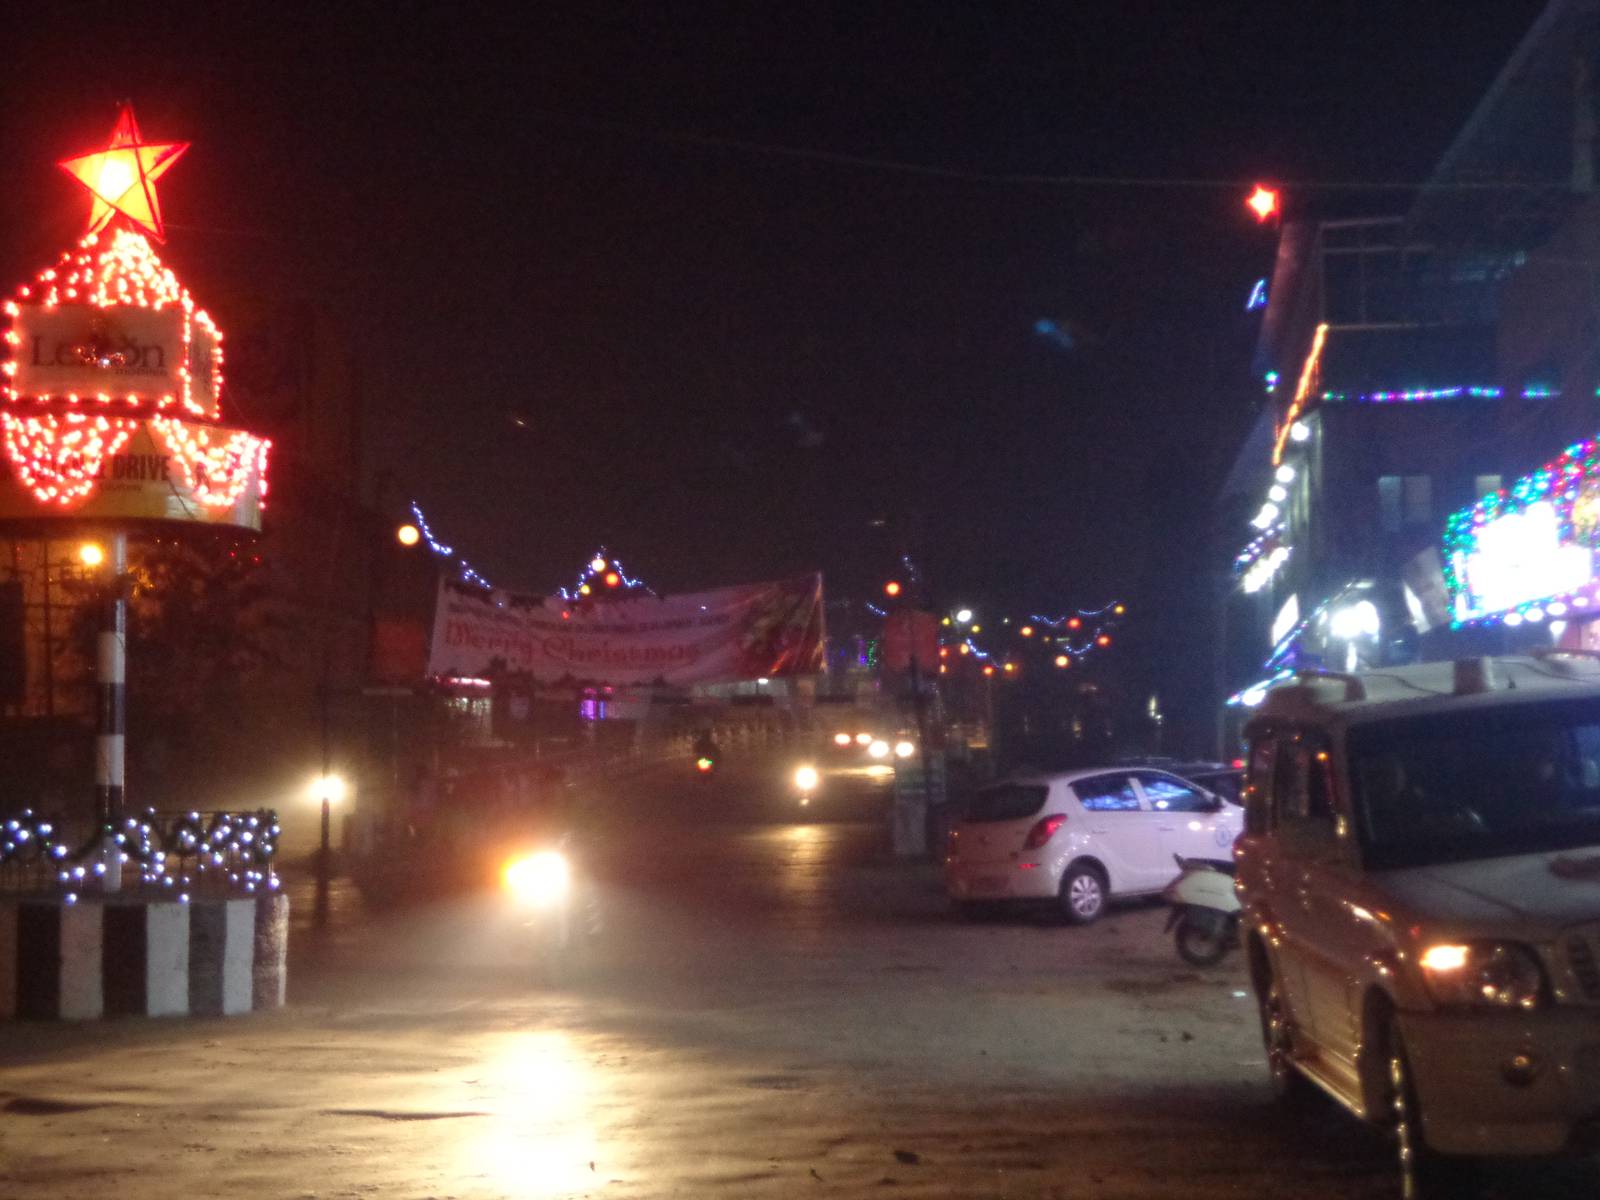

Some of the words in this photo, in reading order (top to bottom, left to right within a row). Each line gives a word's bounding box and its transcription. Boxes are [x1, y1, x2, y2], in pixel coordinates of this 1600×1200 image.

[32, 335, 165, 368] Leon
[112, 455, 170, 481] DRIVE
[446, 619, 533, 663] Merry
[541, 637, 698, 662] Christmas
